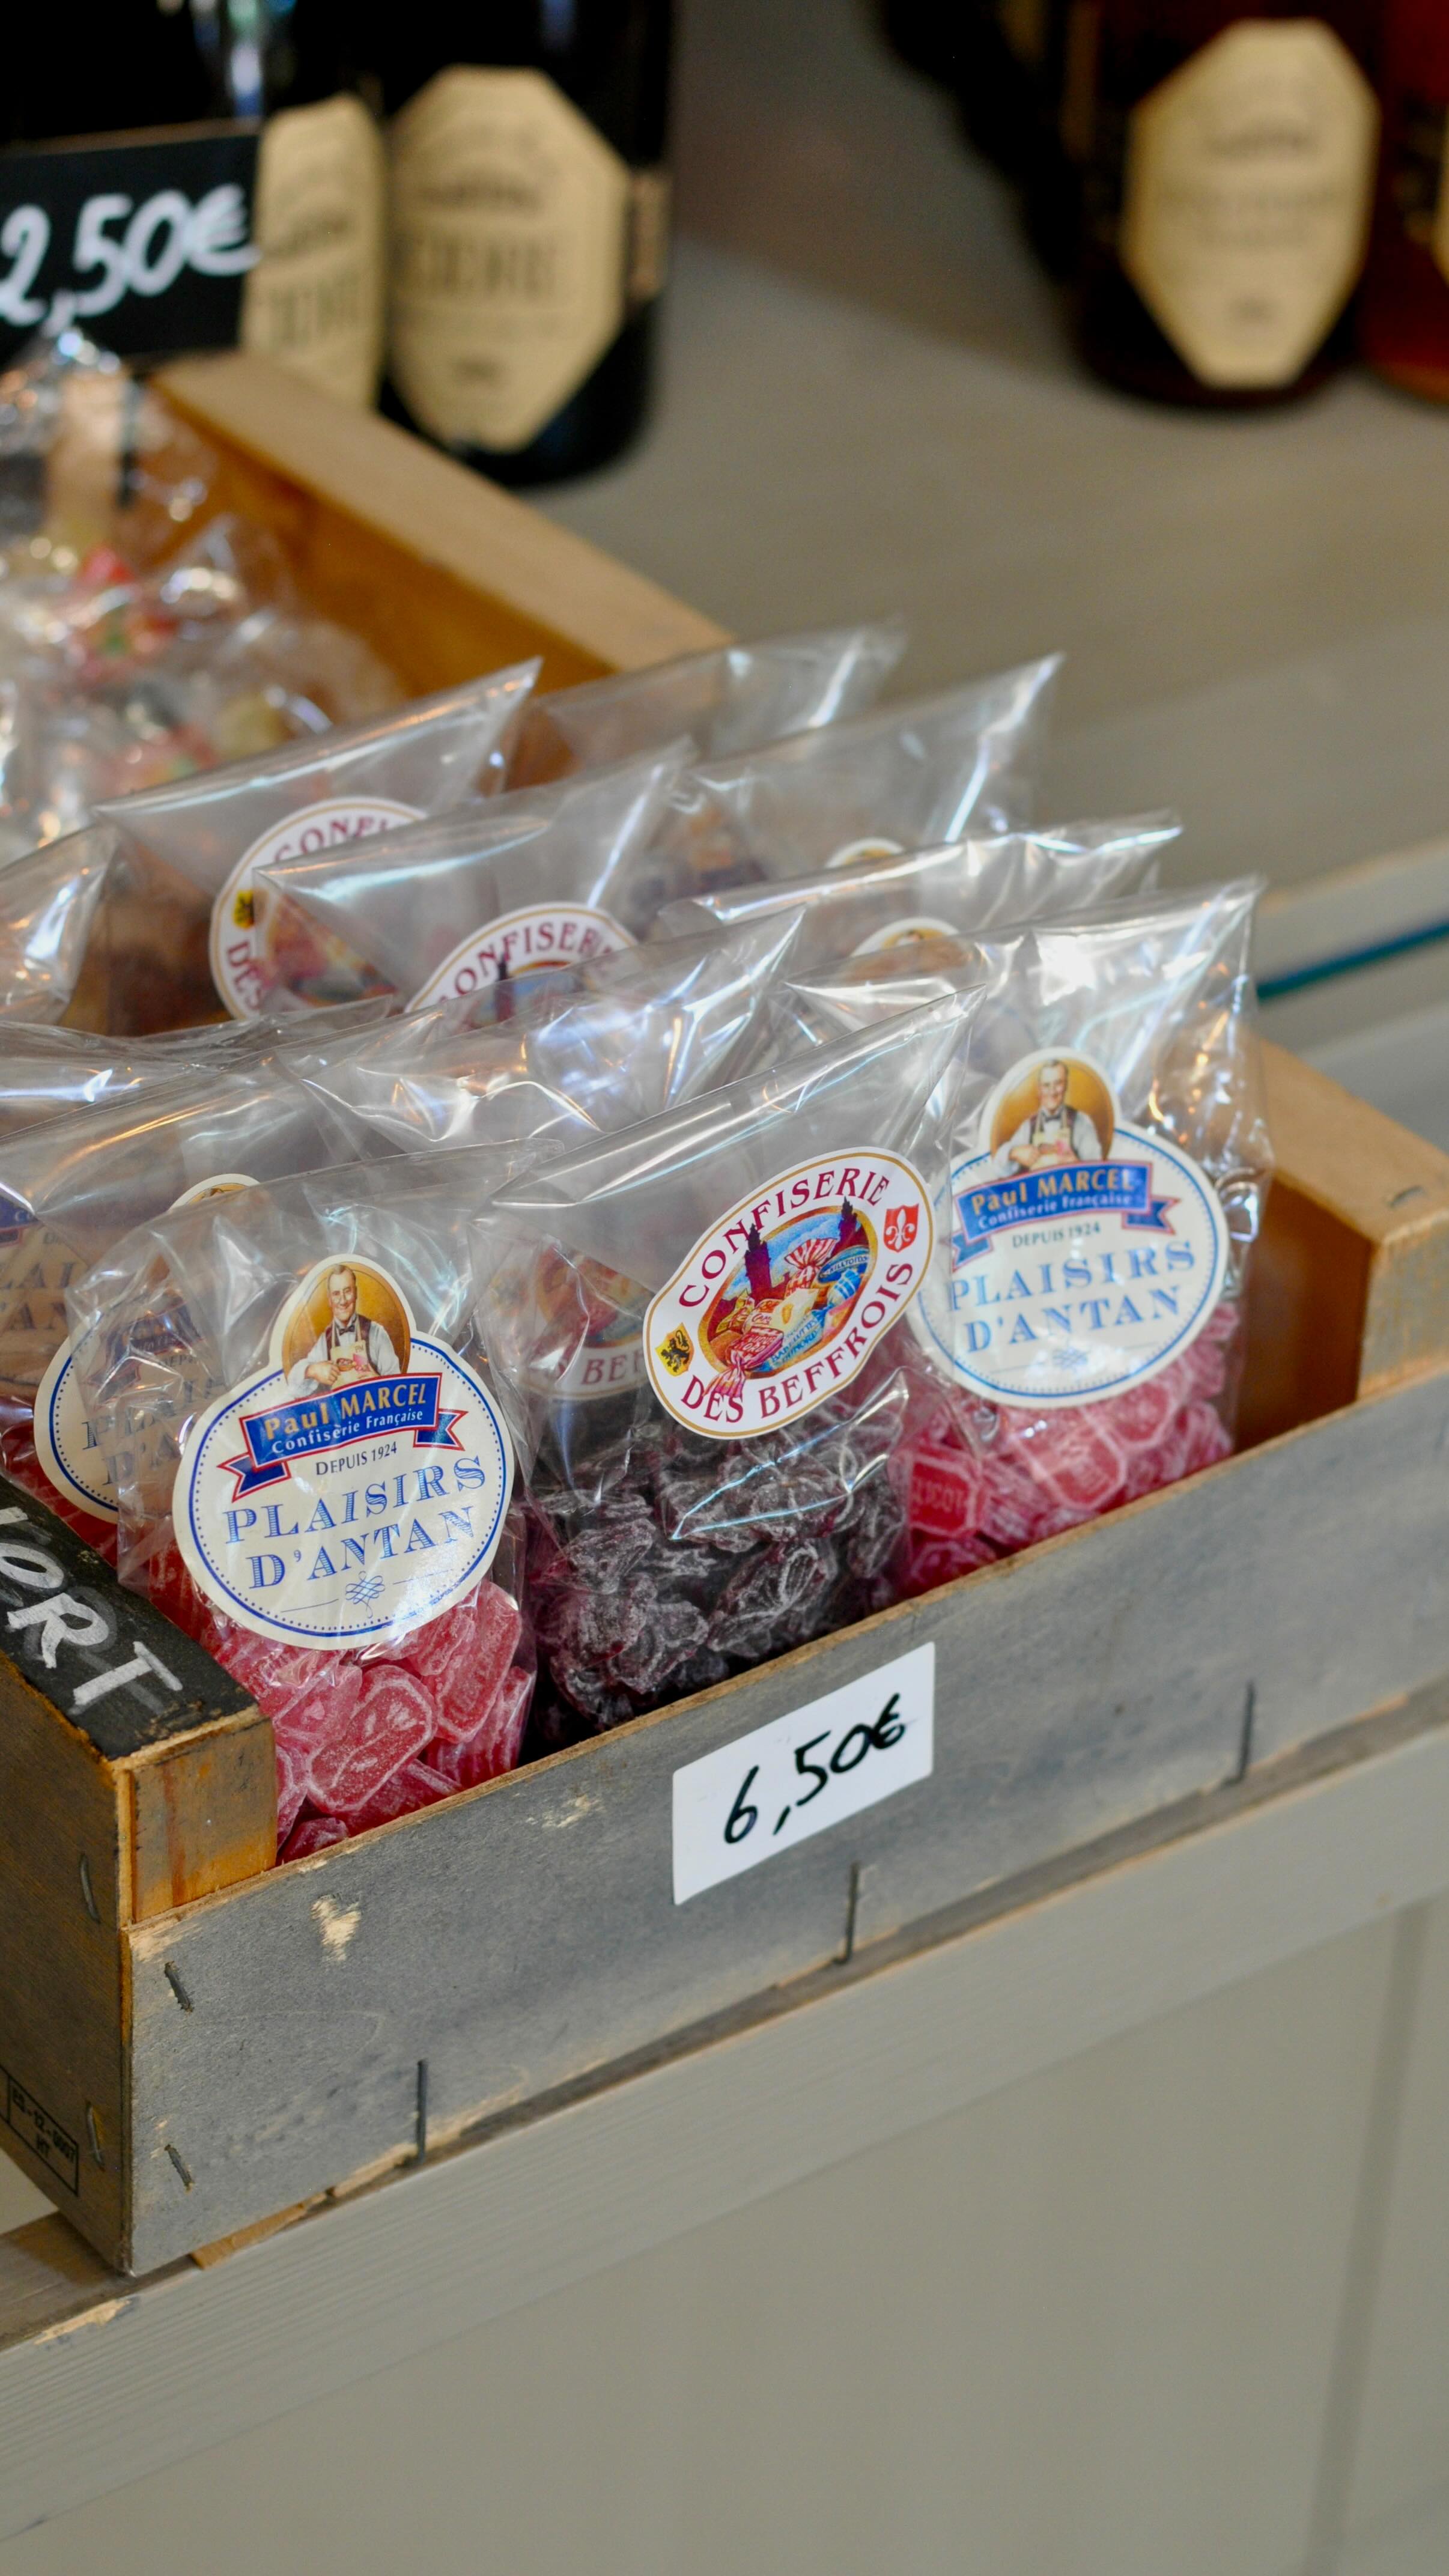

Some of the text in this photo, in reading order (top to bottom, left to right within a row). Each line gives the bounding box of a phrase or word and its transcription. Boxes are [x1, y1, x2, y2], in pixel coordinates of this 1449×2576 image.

[0, 183, 262, 336] 2,50€
[439, 922, 612, 1002] ONFISER
[971, 1168, 1134, 1216] Paul MARCEL
[977, 1197, 1057, 1230] Confiserie
[679, 1167, 890, 1308] CONFISERIE
[1012, 1221, 1101, 1248] DEPUIS 1924
[946, 1240, 1195, 1311] PLAISIRS
[680, 1263, 913, 1423] DES BEFFROIS
[963, 1285, 1182, 1353] D'ANTAN
[264, 1382, 427, 1441] Paul MARCEL
[365, 1409, 424, 1431] Française
[315, 1441, 398, 1476] DEPUIS 1924
[223, 1456, 486, 1544] PLAISIRS
[245, 1506, 475, 1590] D'ANTAN
[0, 1507, 183, 1705] ORT
[724, 1692, 906, 1845] 6,50€
